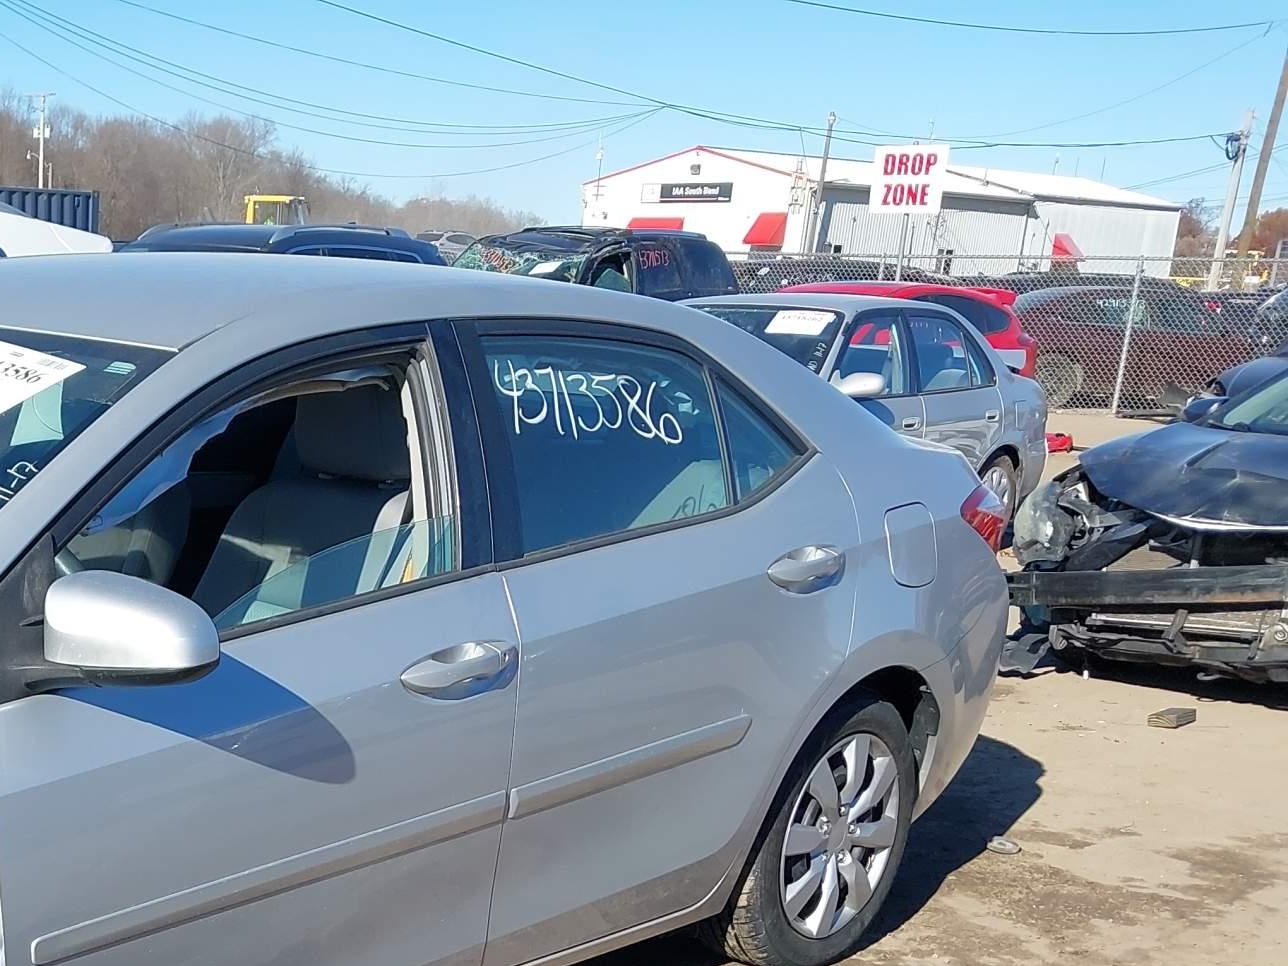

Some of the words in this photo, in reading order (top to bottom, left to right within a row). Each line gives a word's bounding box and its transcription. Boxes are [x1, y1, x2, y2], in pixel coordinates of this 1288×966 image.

[882, 152, 939, 176] DROP
[671, 186, 685, 196] IAA
[684, 186, 703, 196] South
[702, 186, 720, 196] Bend
[880, 183, 931, 207] ZONE
[494, 359, 684, 445] 43713586
